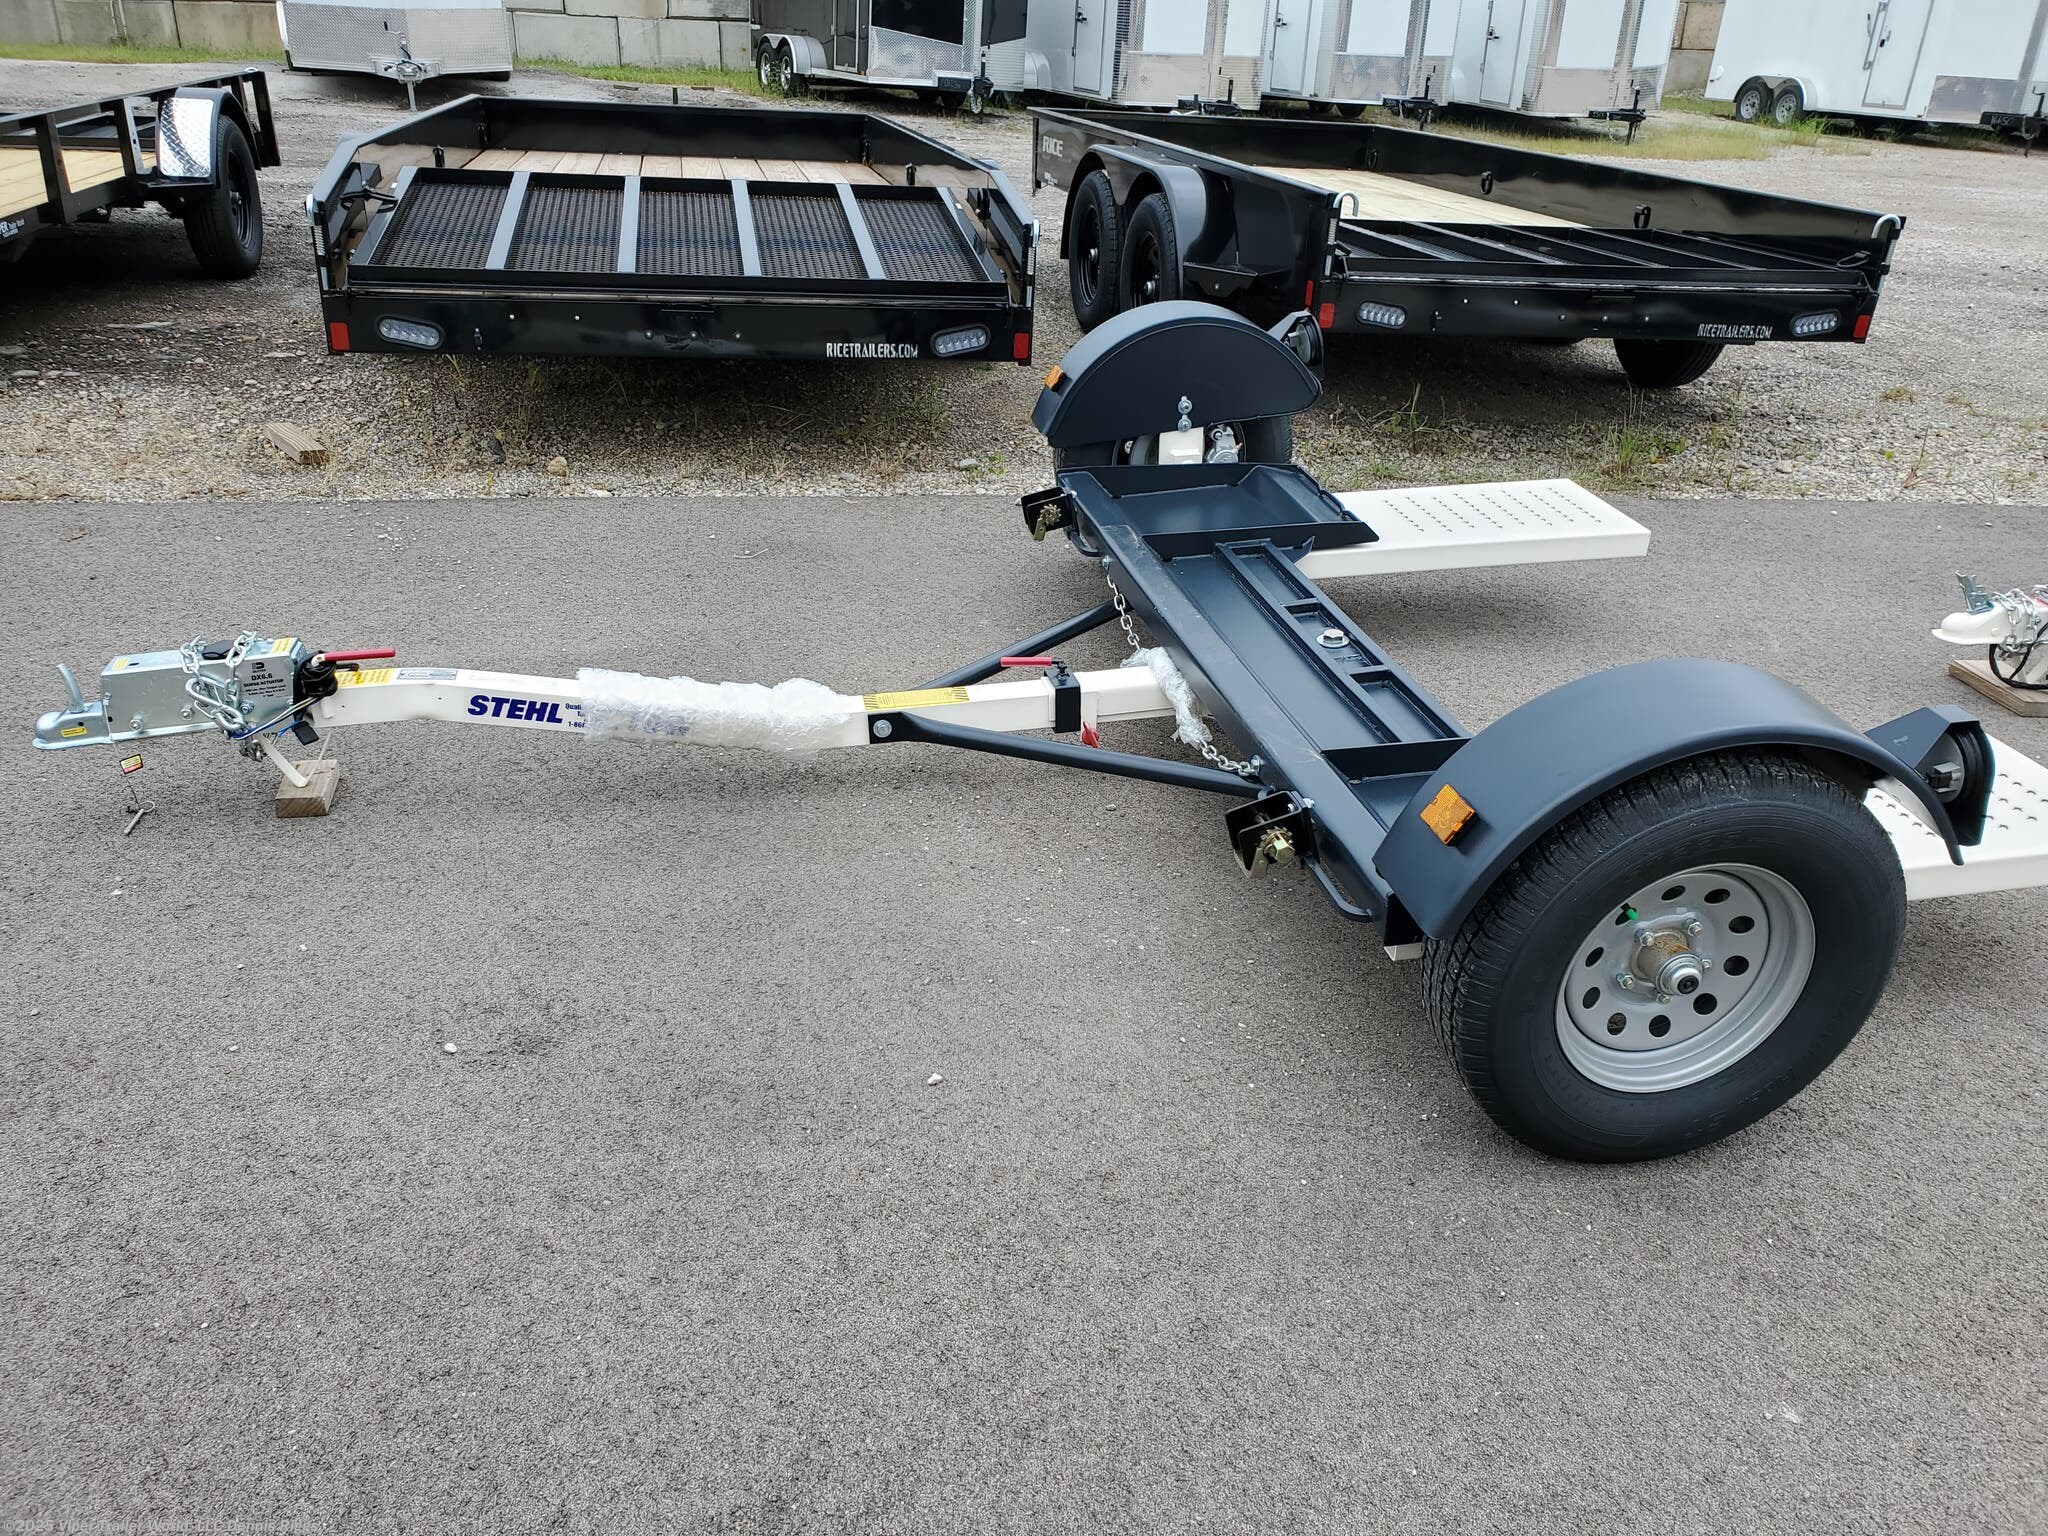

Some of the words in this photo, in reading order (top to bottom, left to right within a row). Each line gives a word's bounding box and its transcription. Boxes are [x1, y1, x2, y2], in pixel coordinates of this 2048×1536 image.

[1042, 135, 1064, 157] RICE
[1697, 323, 1773, 339] RICETRAILERS.COM
[825, 342, 919, 358] RICETRAILERS.COM
[251, 672, 273, 681] DX6.6
[467, 694, 563, 724] STEHL
